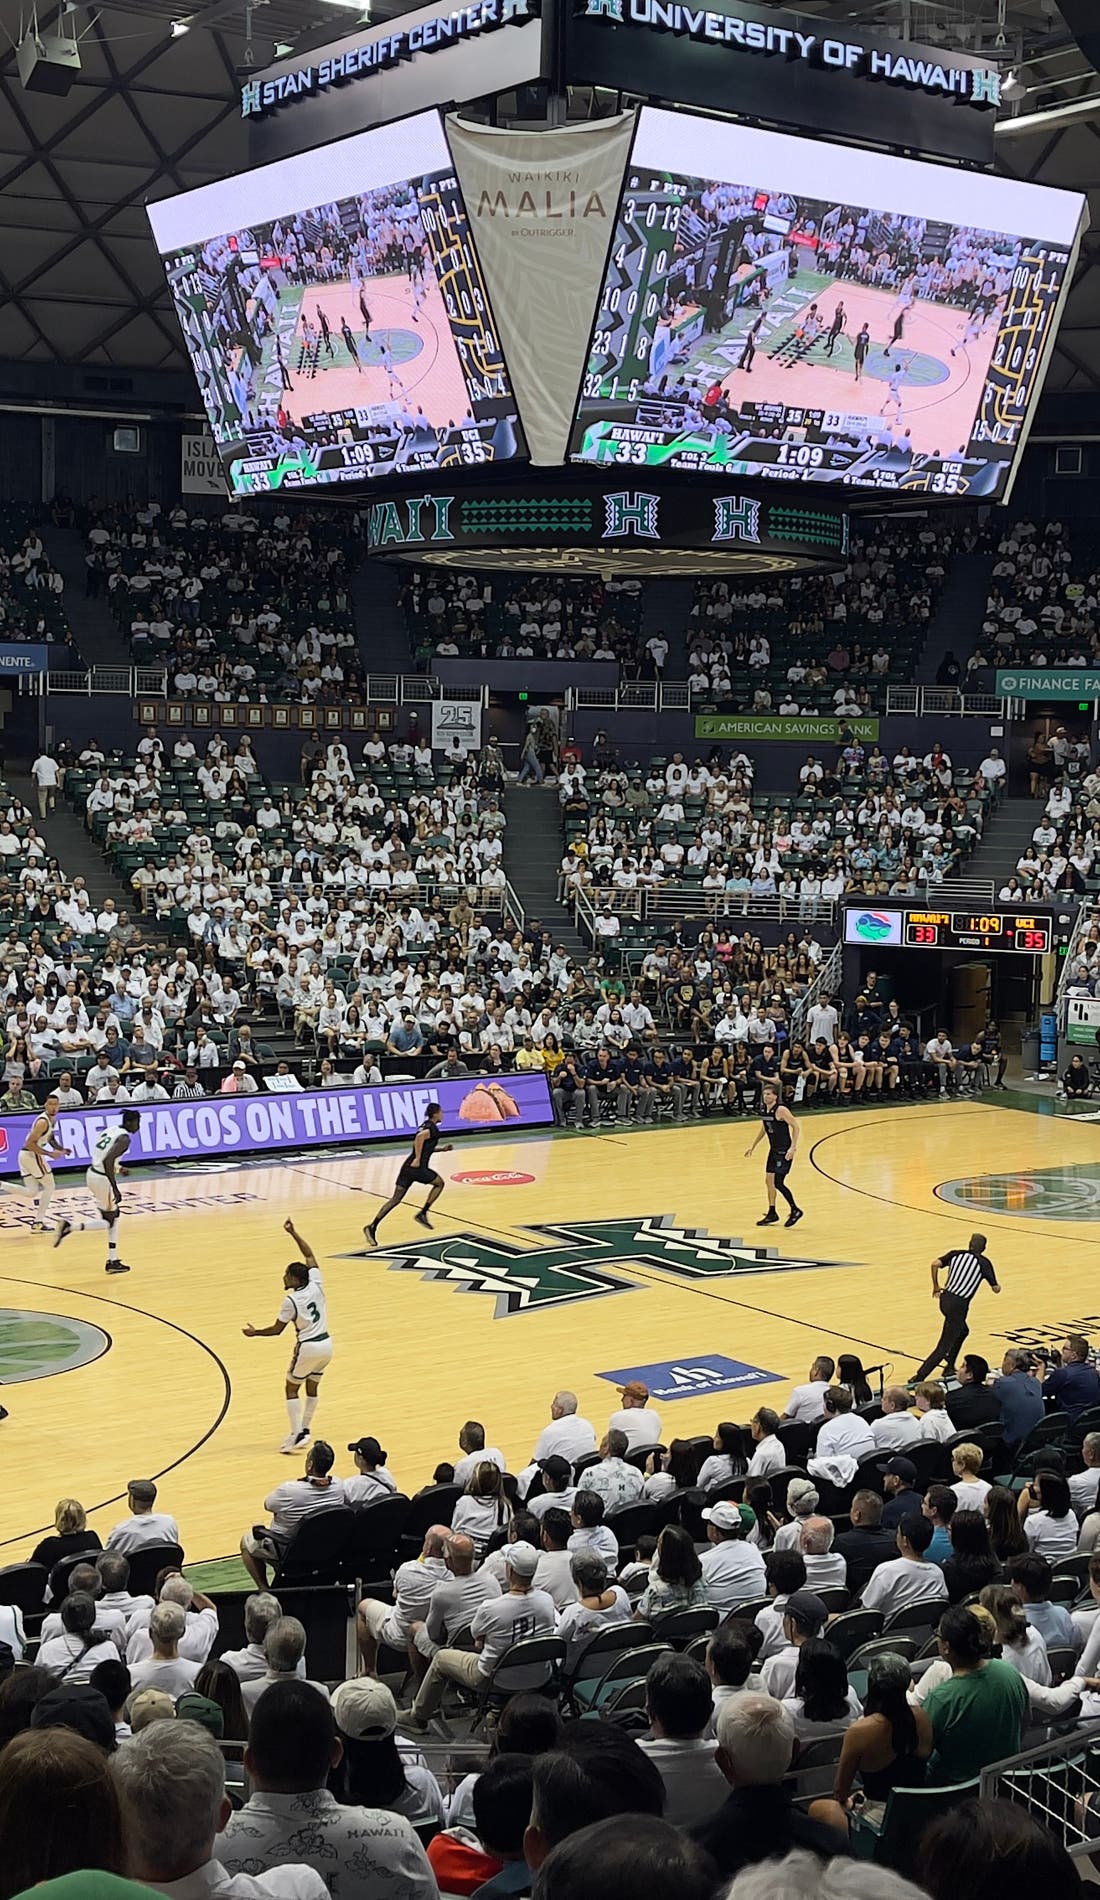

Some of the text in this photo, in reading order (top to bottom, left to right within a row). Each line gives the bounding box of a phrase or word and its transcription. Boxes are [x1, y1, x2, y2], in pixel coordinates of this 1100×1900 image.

[630, 0, 815, 58] UNIVERSITY
[823, 40, 863, 68] OF
[263, 67, 312, 106] STAN
[317, 32, 402, 86] SHERIFF
[408, 0, 498, 51] CENTER
[439, 177, 457, 192] PTS
[509, 171, 579, 184] WAIKIKI
[664, 182, 686, 196] PTS
[477, 190, 607, 218] MALIA
[421, 200, 461, 233] 00 0 1
[624, 200, 679, 232] 3 0 13
[437, 243, 473, 275] 1 0 1
[615, 246, 667, 273] 4 1 0
[1048, 252, 1067, 263] PTS
[171, 272, 203, 300] 3 0 13
[1012, 266, 1057, 293] 00 0 1
[446, 287, 484, 318] 2 0 3
[602, 288, 657, 317] 10 0 0
[193, 312, 201, 333] 1
[202, 310, 211, 331] 0
[1022, 311, 1031, 330] 0
[1038, 309, 1046, 332] 1
[472, 332, 482, 357] 1
[486, 330, 495, 354] 0
[593, 331, 648, 361] 23 1 8
[203, 349, 212, 370] 0
[213, 347, 222, 368] 0
[994, 344, 1036, 370] 2 0 3
[201, 383, 233, 408] 23 1 8
[466, 373, 507, 402] 15 0 4
[583, 373, 638, 402] 32 1 5
[1002, 384, 1011, 405] 1
[1016, 385, 1025, 408] 0
[786, 410, 802, 423] 35
[826, 415, 840, 427] 33
[225, 421, 233, 441] 1
[462, 428, 480, 442] UCI
[611, 428, 665, 444] HAWAI'I
[971, 419, 1015, 444] 15 0 4
[341, 445, 374, 466] 1:09
[461, 442, 486, 464] 35
[615, 442, 647, 465] 33
[700, 453, 708, 462] 3
[776, 444, 824, 467] 1:09
[670, 459, 733, 473] Team Fouls 6
[941, 463, 962, 474] UCI
[252, 472, 271, 492] 33
[843, 474, 850, 484] 6
[851, 476, 875, 488] Team
[932, 473, 960, 494] 35
[601, 491, 662, 540] H
[711, 495, 762, 544] H
[1019, 678, 1080, 691] FINANCE
[441, 705, 473, 725] 25
[718, 722, 781, 734] AMERICAN
[785, 724, 835, 735] SAVINGS
[970, 917, 1000, 932] 1:09
[1015, 918, 1035, 929] UCI
[915, 927, 934, 943] 33
[1025, 932, 1044, 948] 35
[139, 1104, 242, 1153] TACOS
[246, 1100, 296, 1143] ON
[297, 1095, 362, 1137] THE
[307, 1301, 320, 1323] 3
